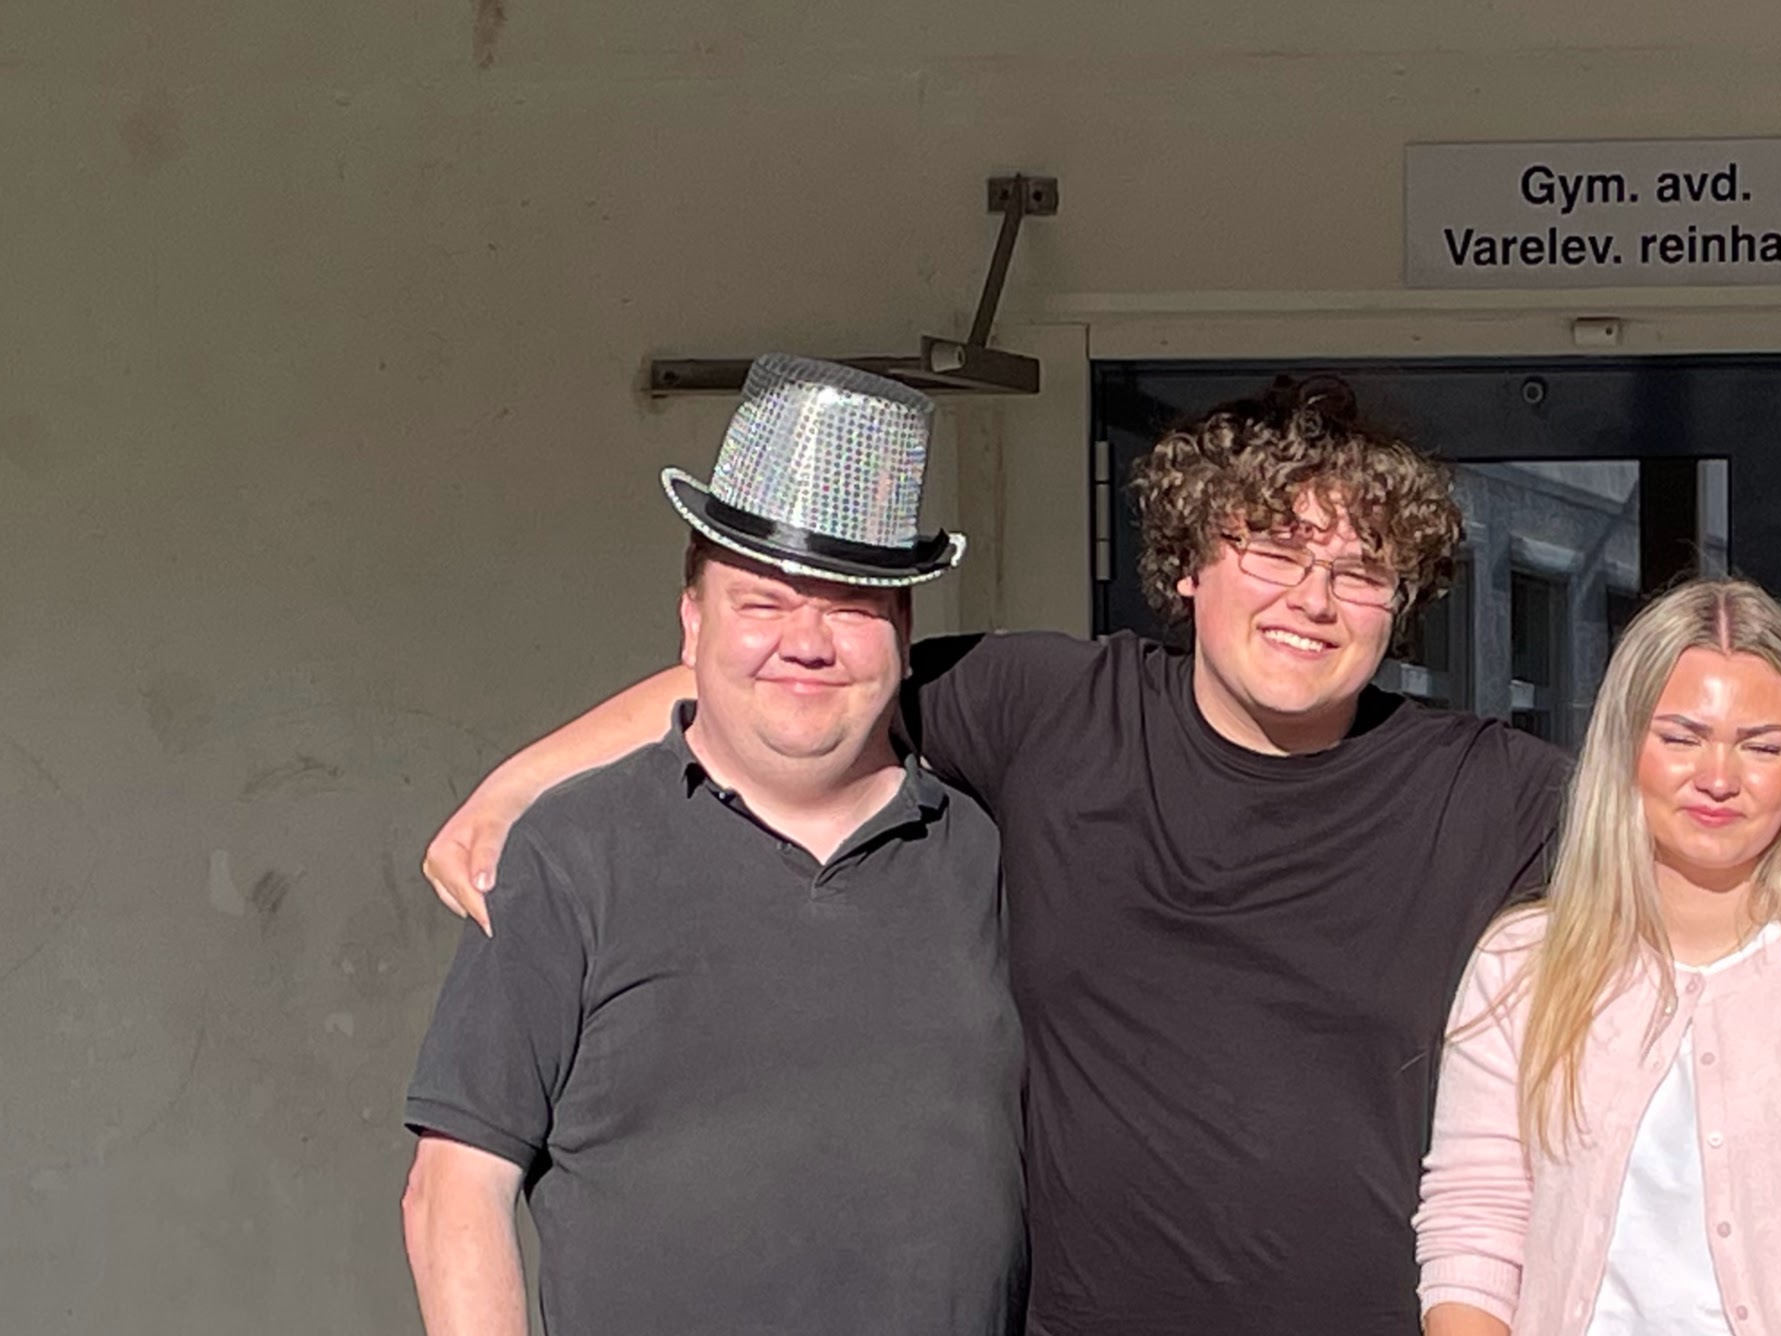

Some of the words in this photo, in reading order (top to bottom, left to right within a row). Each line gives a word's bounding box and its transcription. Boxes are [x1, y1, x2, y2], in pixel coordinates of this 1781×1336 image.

[1521, 165, 1639, 215] Gym.
[1656, 162, 1752, 203] avd.
[1443, 226, 1623, 266] Varelev.
